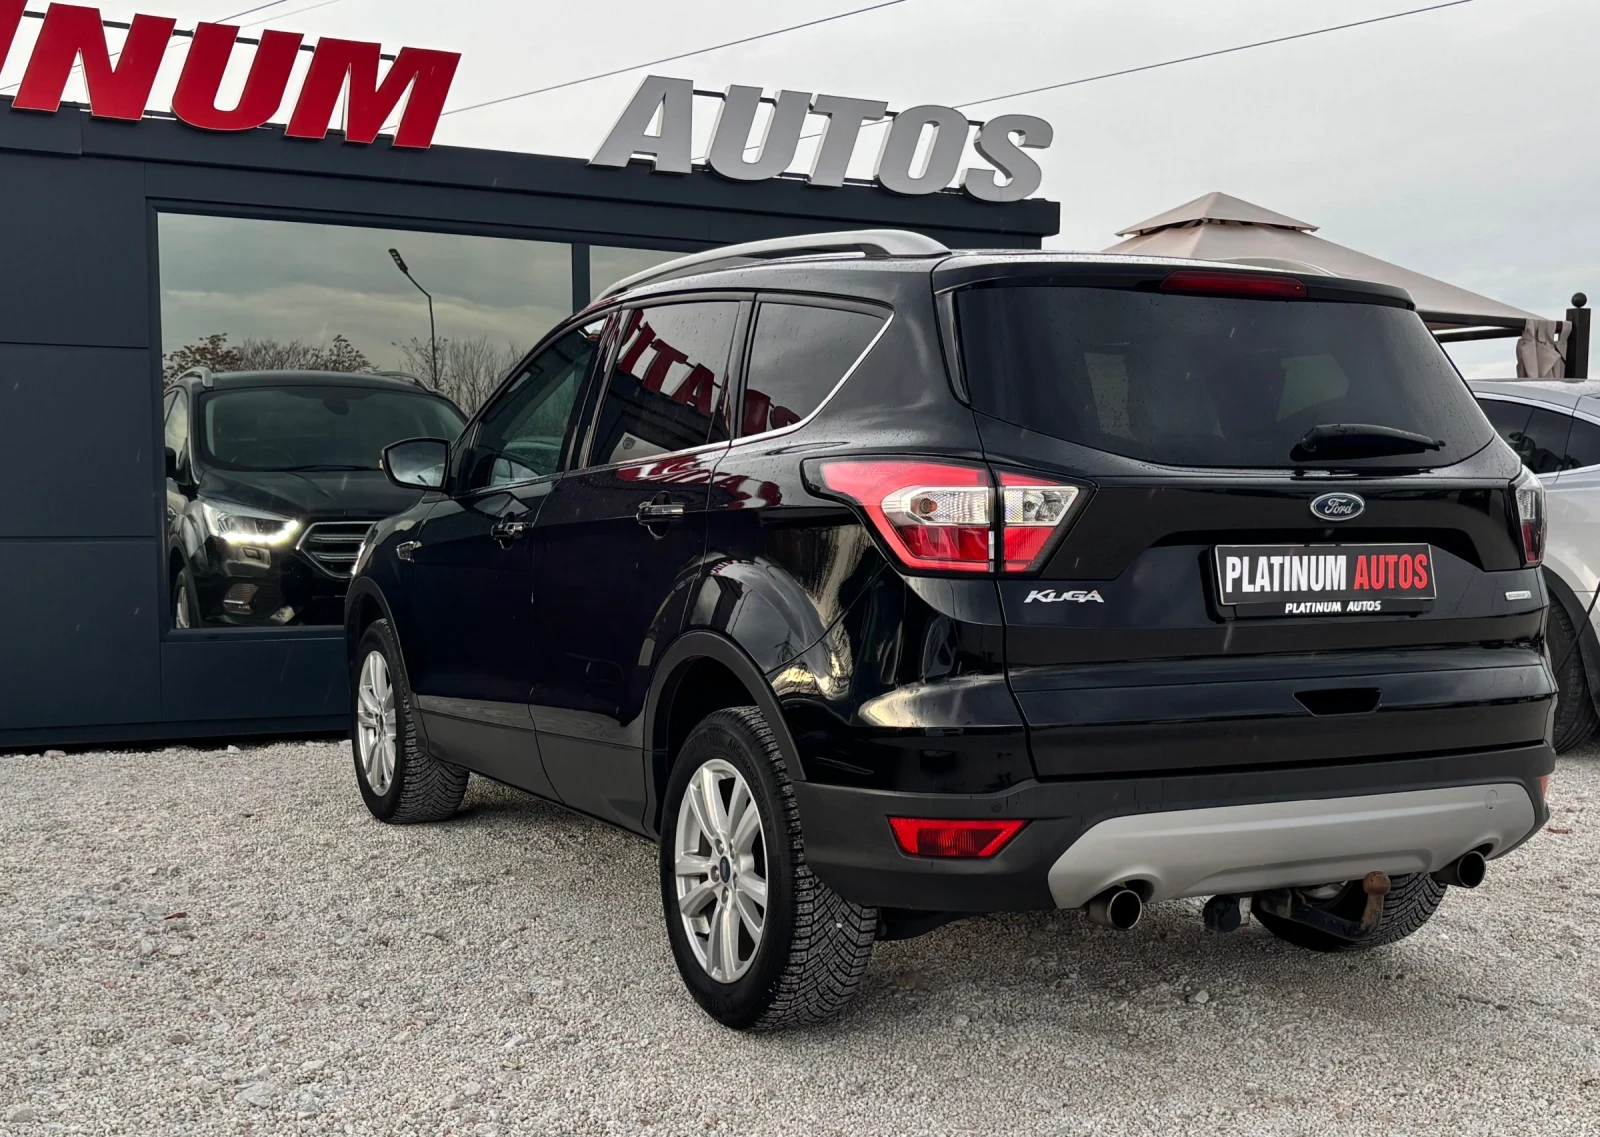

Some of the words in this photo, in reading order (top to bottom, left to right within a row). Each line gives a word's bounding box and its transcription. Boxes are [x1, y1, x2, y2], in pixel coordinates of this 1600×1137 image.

[0, 0, 462, 149] NUM
[586, 74, 1054, 202] AUTOS
[1324, 498, 1354, 514] Ford
[1225, 555, 1347, 593] PLATINUM
[1353, 553, 1428, 590] AUTOS
[1023, 589, 1105, 603] KUGA
[1285, 602, 1342, 614] PLATINUM
[1346, 600, 1382, 612] AUTOS
